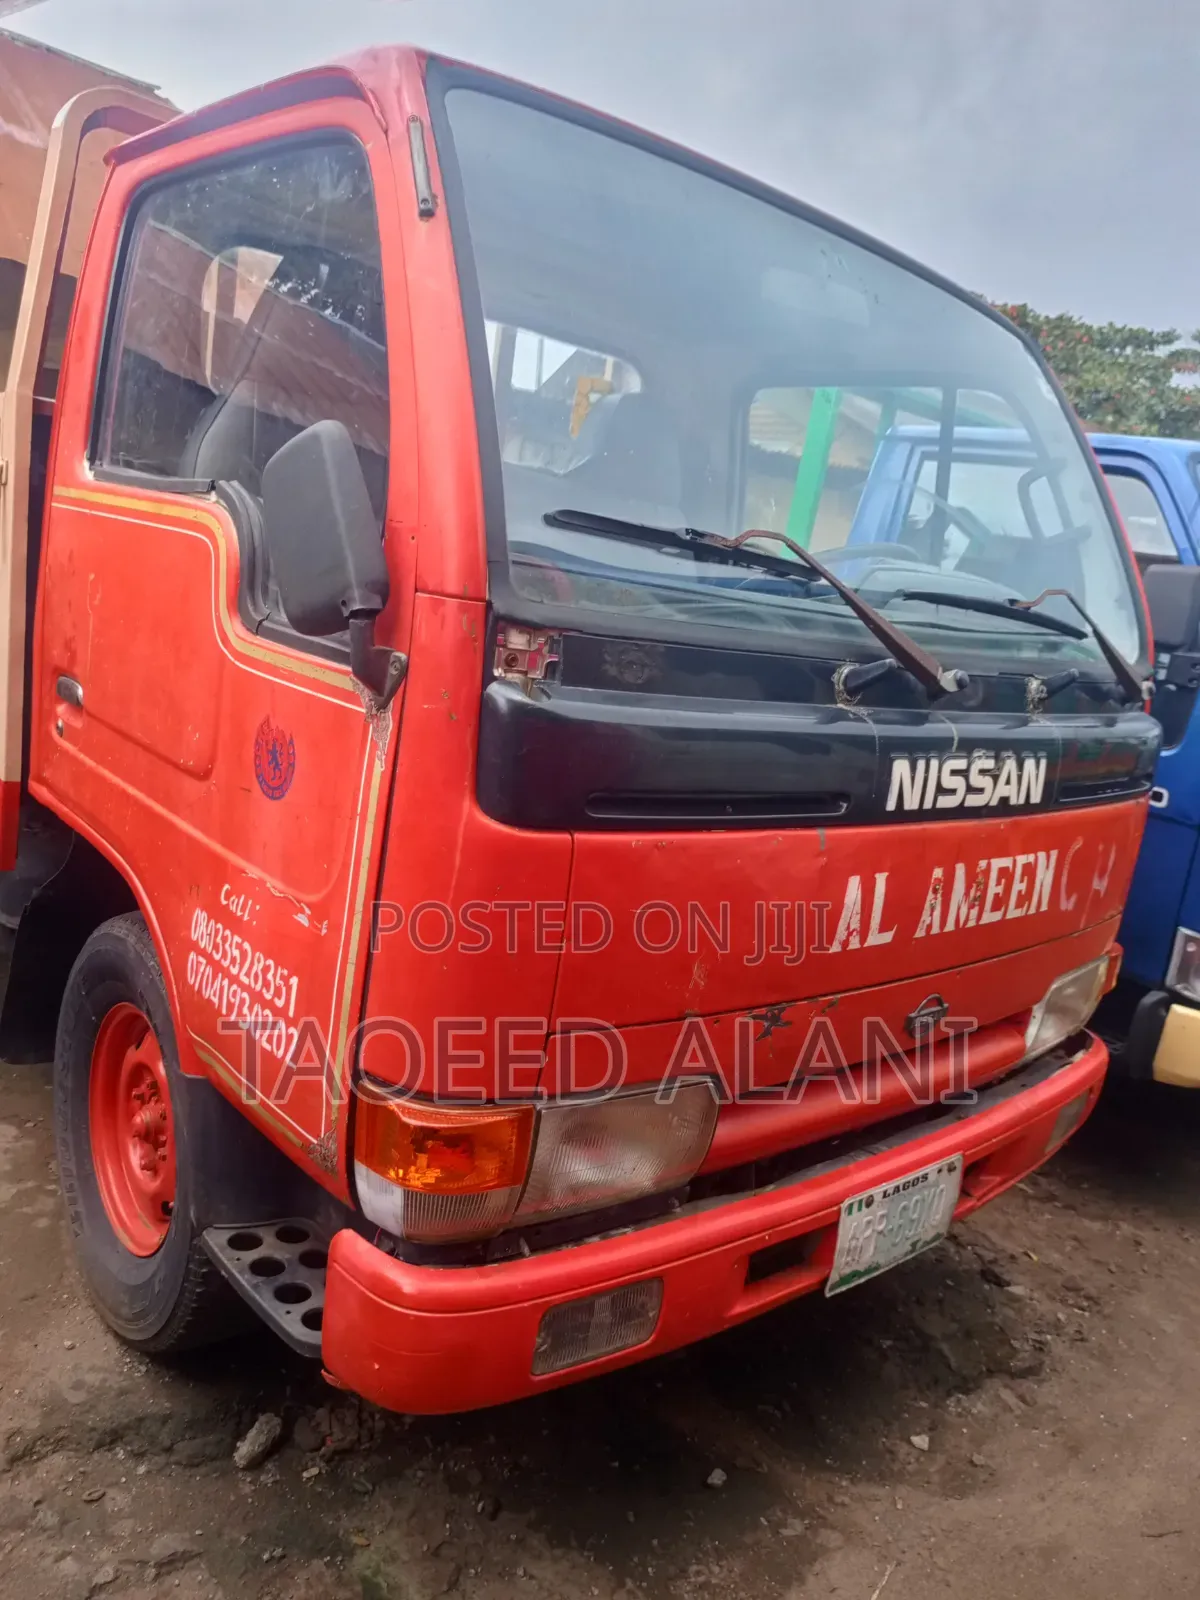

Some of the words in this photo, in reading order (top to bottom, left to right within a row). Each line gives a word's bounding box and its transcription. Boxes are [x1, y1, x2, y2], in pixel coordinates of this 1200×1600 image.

[886, 752, 1047, 812] NISSAN
[829, 871, 897, 953] AL
[913, 849, 1058, 938] AMEEN
[187, 951, 298, 1072] 07041930202
[191, 907, 298, 1018] 08033528351
[882, 1172, 929, 1199] LAGOS
